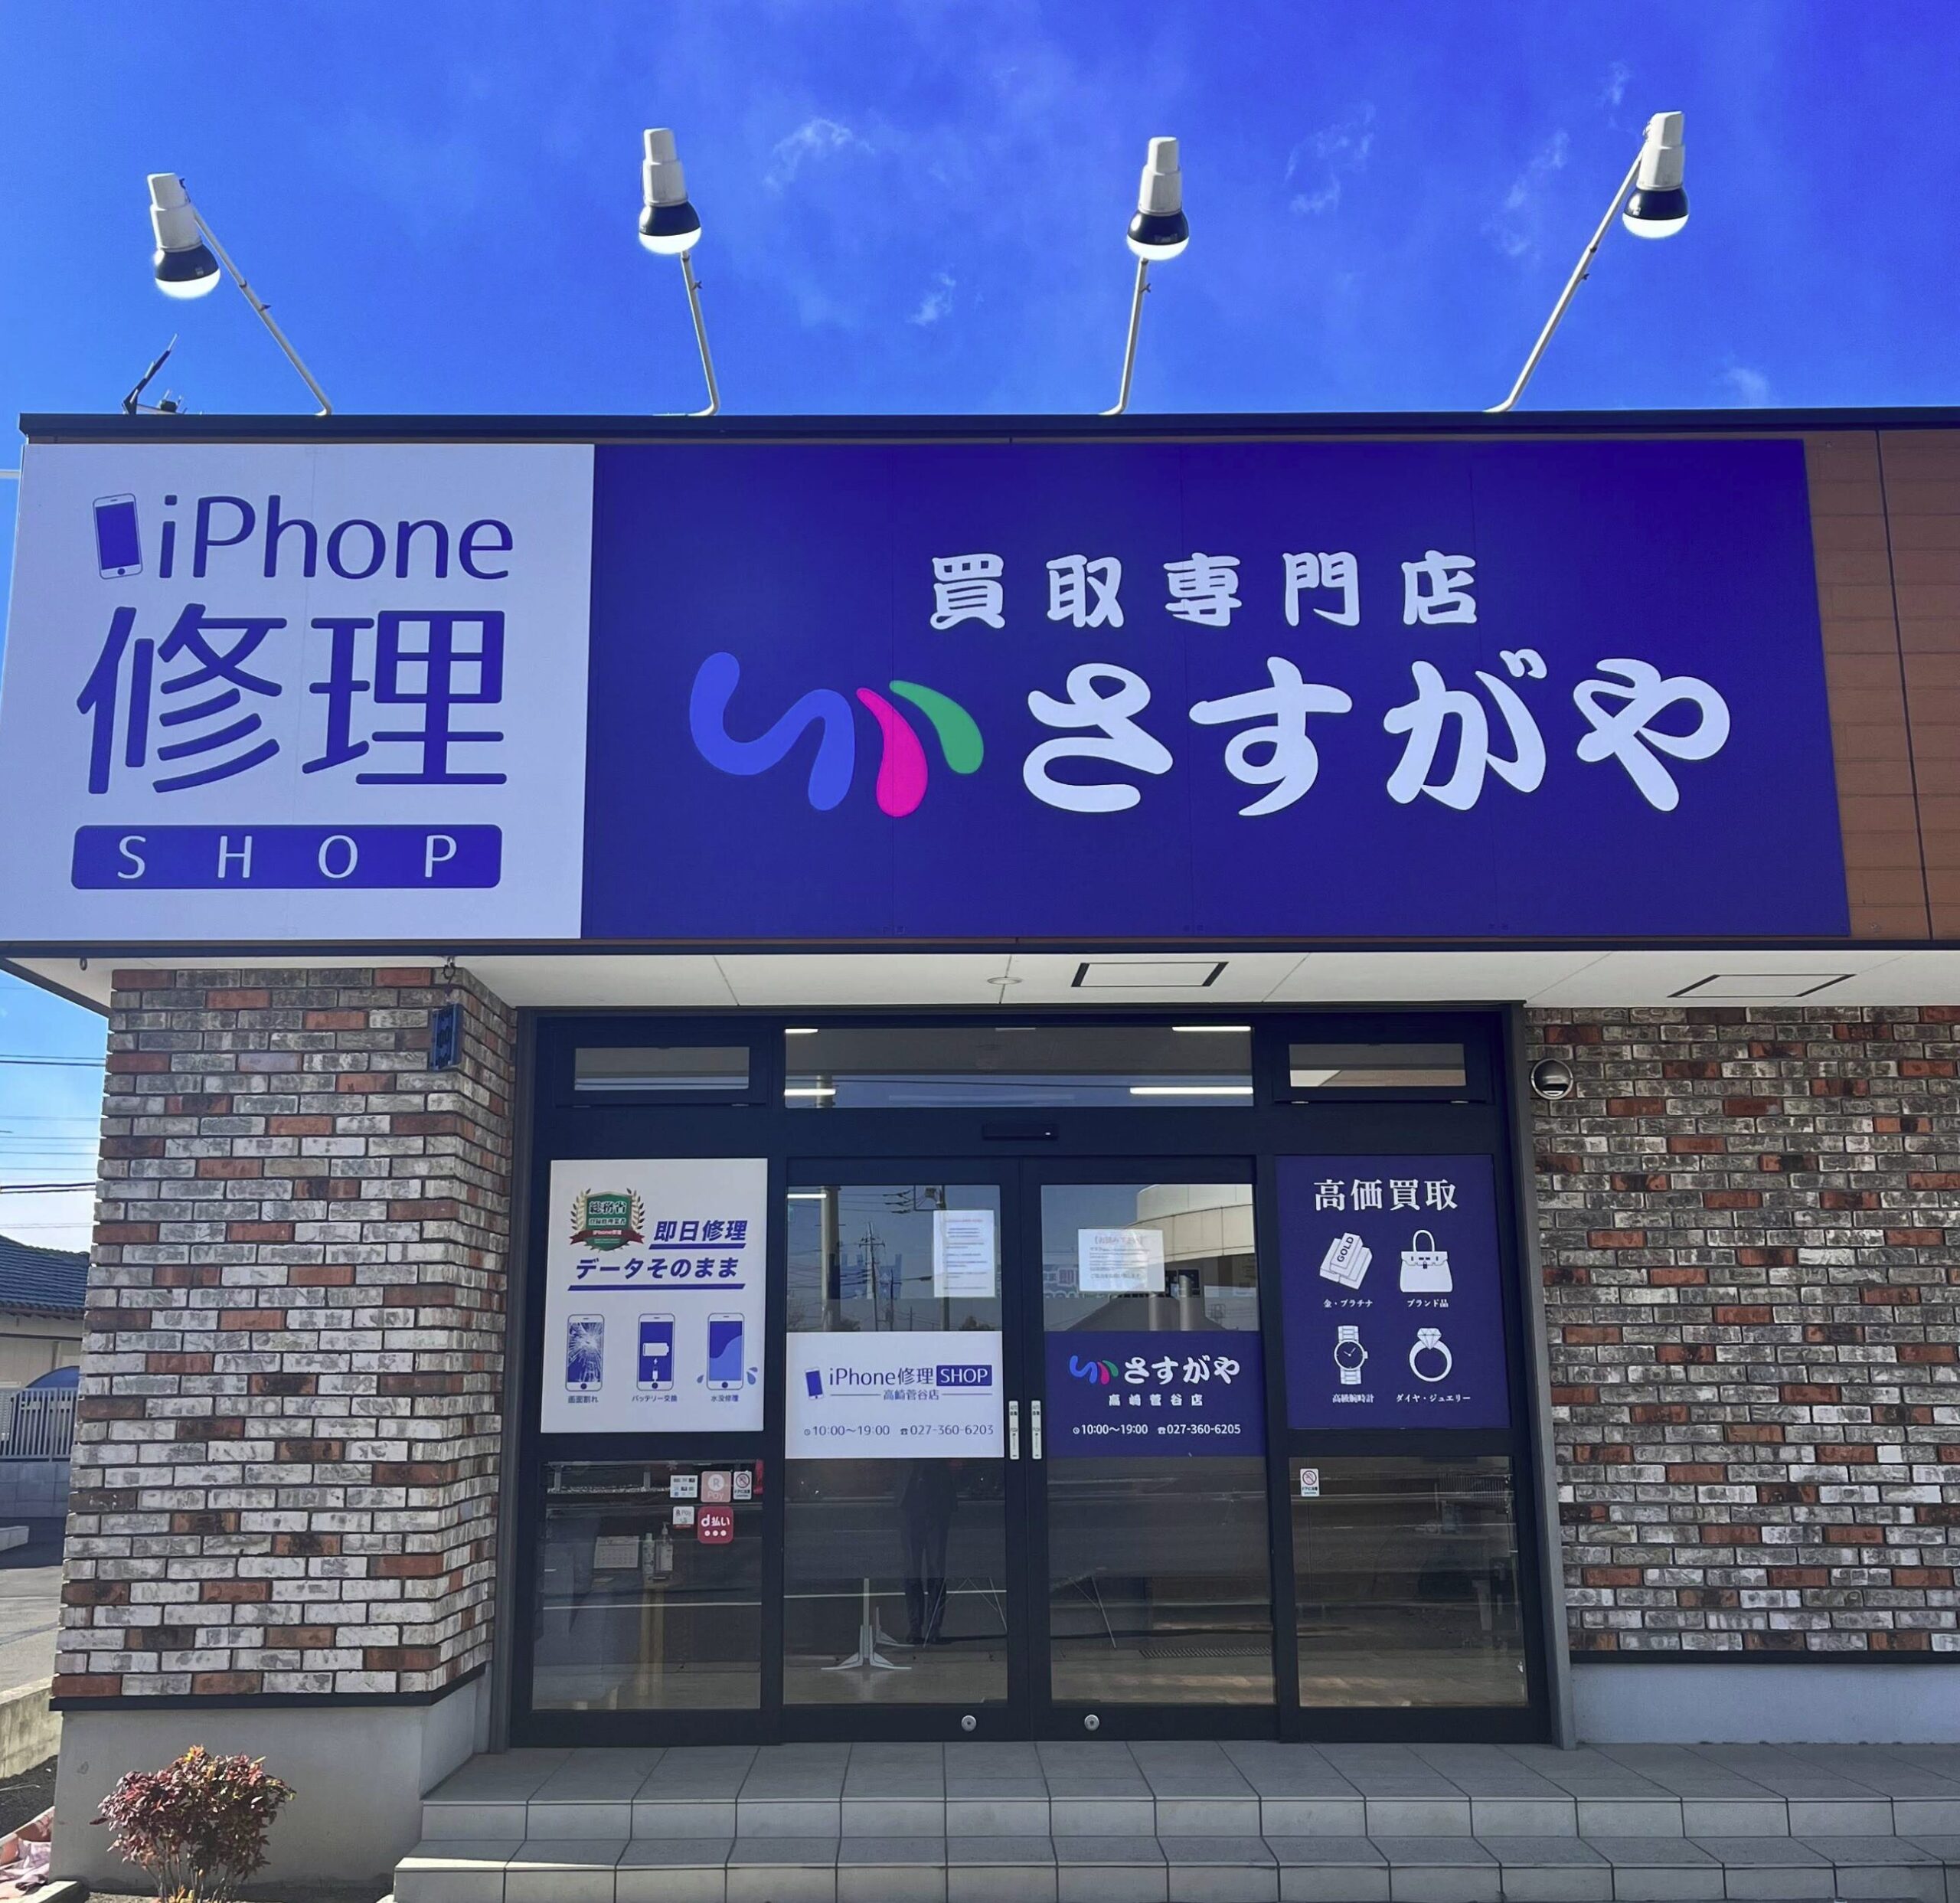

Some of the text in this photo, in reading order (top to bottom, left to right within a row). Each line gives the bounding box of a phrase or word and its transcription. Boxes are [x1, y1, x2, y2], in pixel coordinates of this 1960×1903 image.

[158, 494, 514, 580] iPhone
[929, 550, 1478, 630] 買取専門店
[77, 603, 507, 795] 修理
[1022, 648, 1732, 817] さすがや
[116, 835, 457, 879] SHOP
[1313, 1179, 1459, 1211] 高価買取
[653, 1220, 748, 1242] 即日修理
[1336, 1236, 1354, 1263] GOLD
[576, 1257, 739, 1280] データそのまま
[940, 1368, 988, 1383] SHOP
[1124, 1355, 1240, 1385] さすがや
[910, 1424, 994, 1435] 027-360-6203
[1167, 1424, 1241, 1434] 027-360-6205
[701, 1514, 730, 1527] d払い
